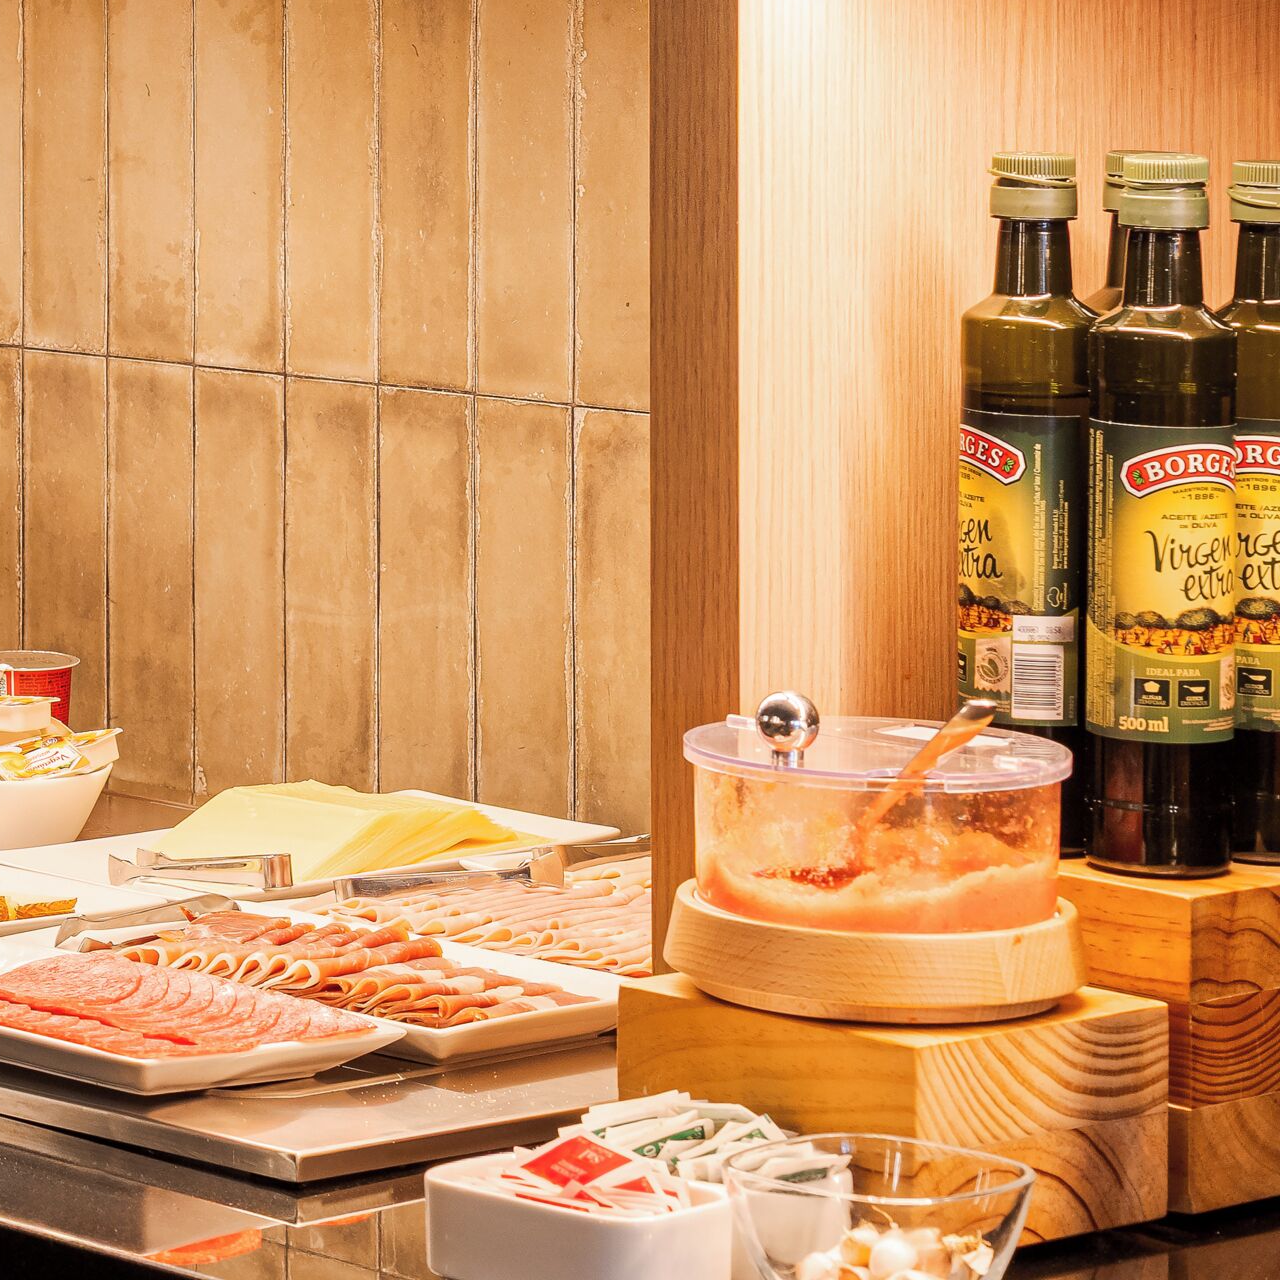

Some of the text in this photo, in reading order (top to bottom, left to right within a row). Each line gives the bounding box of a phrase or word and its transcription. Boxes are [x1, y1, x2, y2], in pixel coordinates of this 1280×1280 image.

[1143, 453, 1236, 482] BORGES
[1180, 566, 1235, 602] extra
[1236, 655, 1261, 665] PARA
[1145, 667, 1201, 677] IDEAL PARA
[1118, 716, 1169, 733] 500 ml
